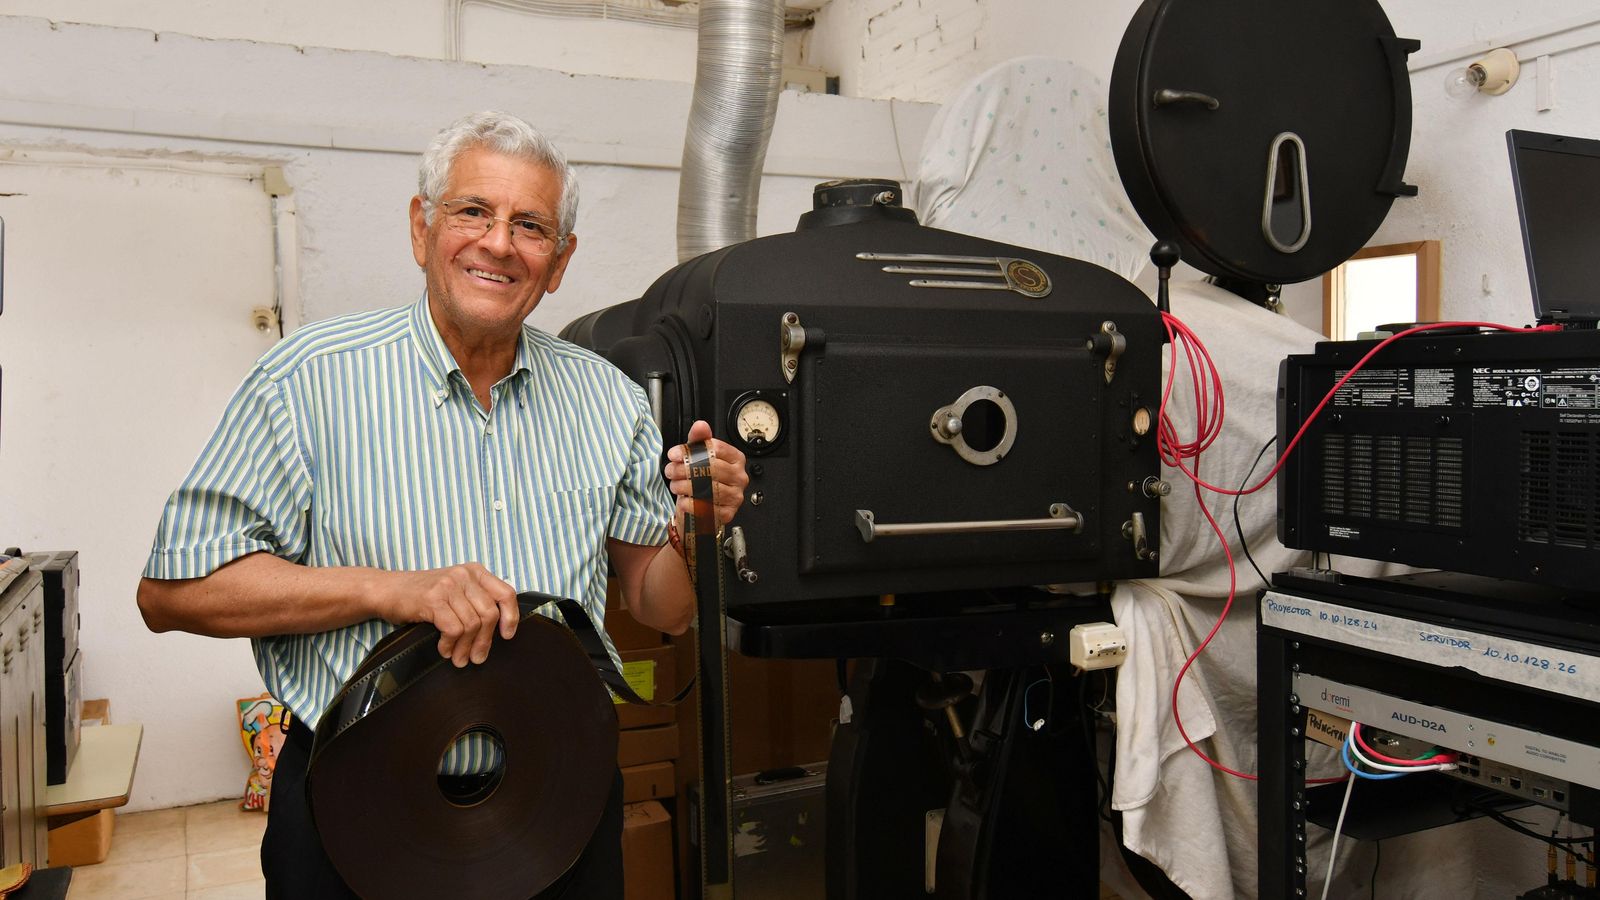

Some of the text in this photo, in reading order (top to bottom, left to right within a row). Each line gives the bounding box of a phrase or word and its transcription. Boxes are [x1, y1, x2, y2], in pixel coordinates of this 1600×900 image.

[1266, 598, 1378, 631] PROYECTOR 10.10.128.24
[1419, 631, 1577, 674] SERVIDOR 10.10.128.26
[1320, 687, 1350, 708] doremi
[1391, 711, 1447, 733] AUD-D2A
